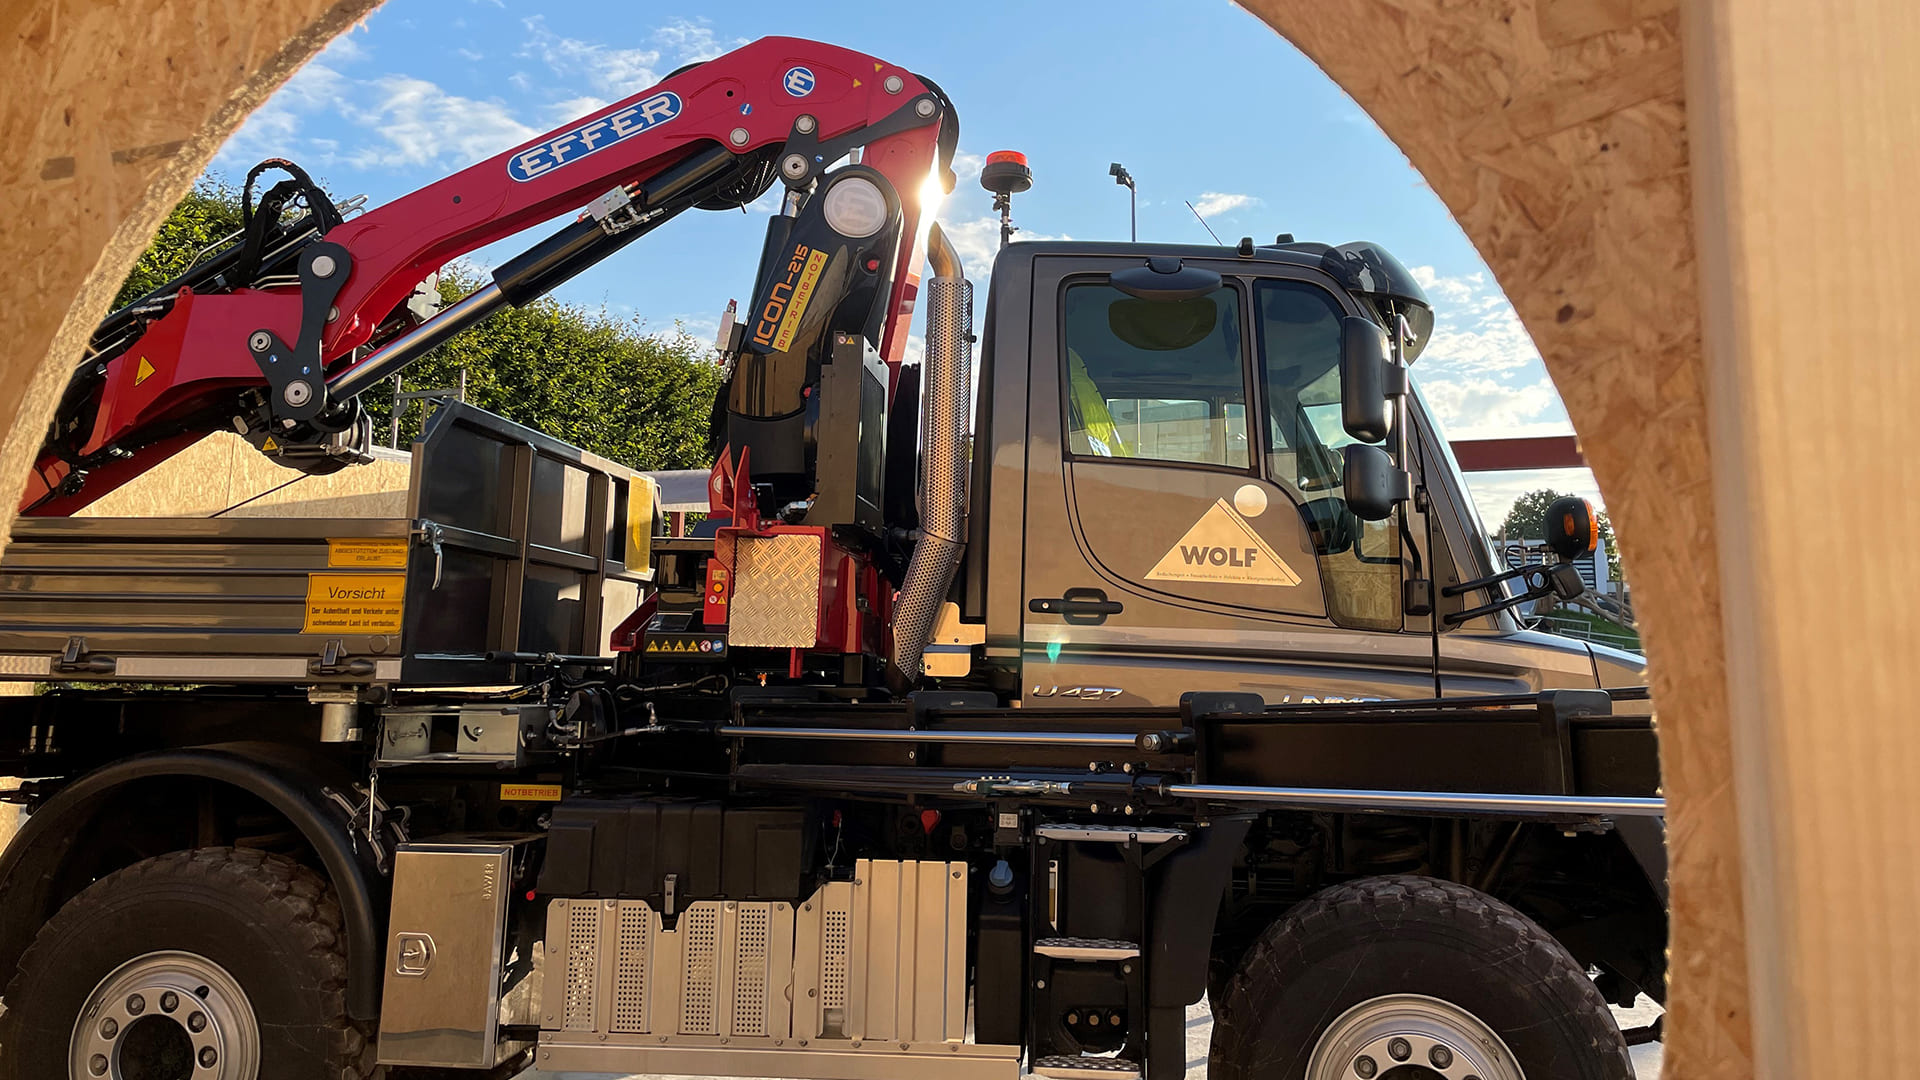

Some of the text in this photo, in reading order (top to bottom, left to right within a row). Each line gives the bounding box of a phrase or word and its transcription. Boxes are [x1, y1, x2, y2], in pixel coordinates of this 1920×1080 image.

[517, 94, 671, 178] EFFER
[753, 243, 809, 346] ICON-215
[777, 253, 823, 348] NOTBETRIEB
[1180, 545, 1258, 568] WOLF
[328, 586, 386, 600] Vorsicht
[311, 607, 321, 615] Der
[351, 607, 362, 615] und
[363, 607, 384, 615] Verkehr
[312, 619, 347, 627] schwebender
[349, 619, 360, 627] Last
[1033, 685, 1123, 701] U 427
[504, 788, 559, 797] NOTBETRIEB
